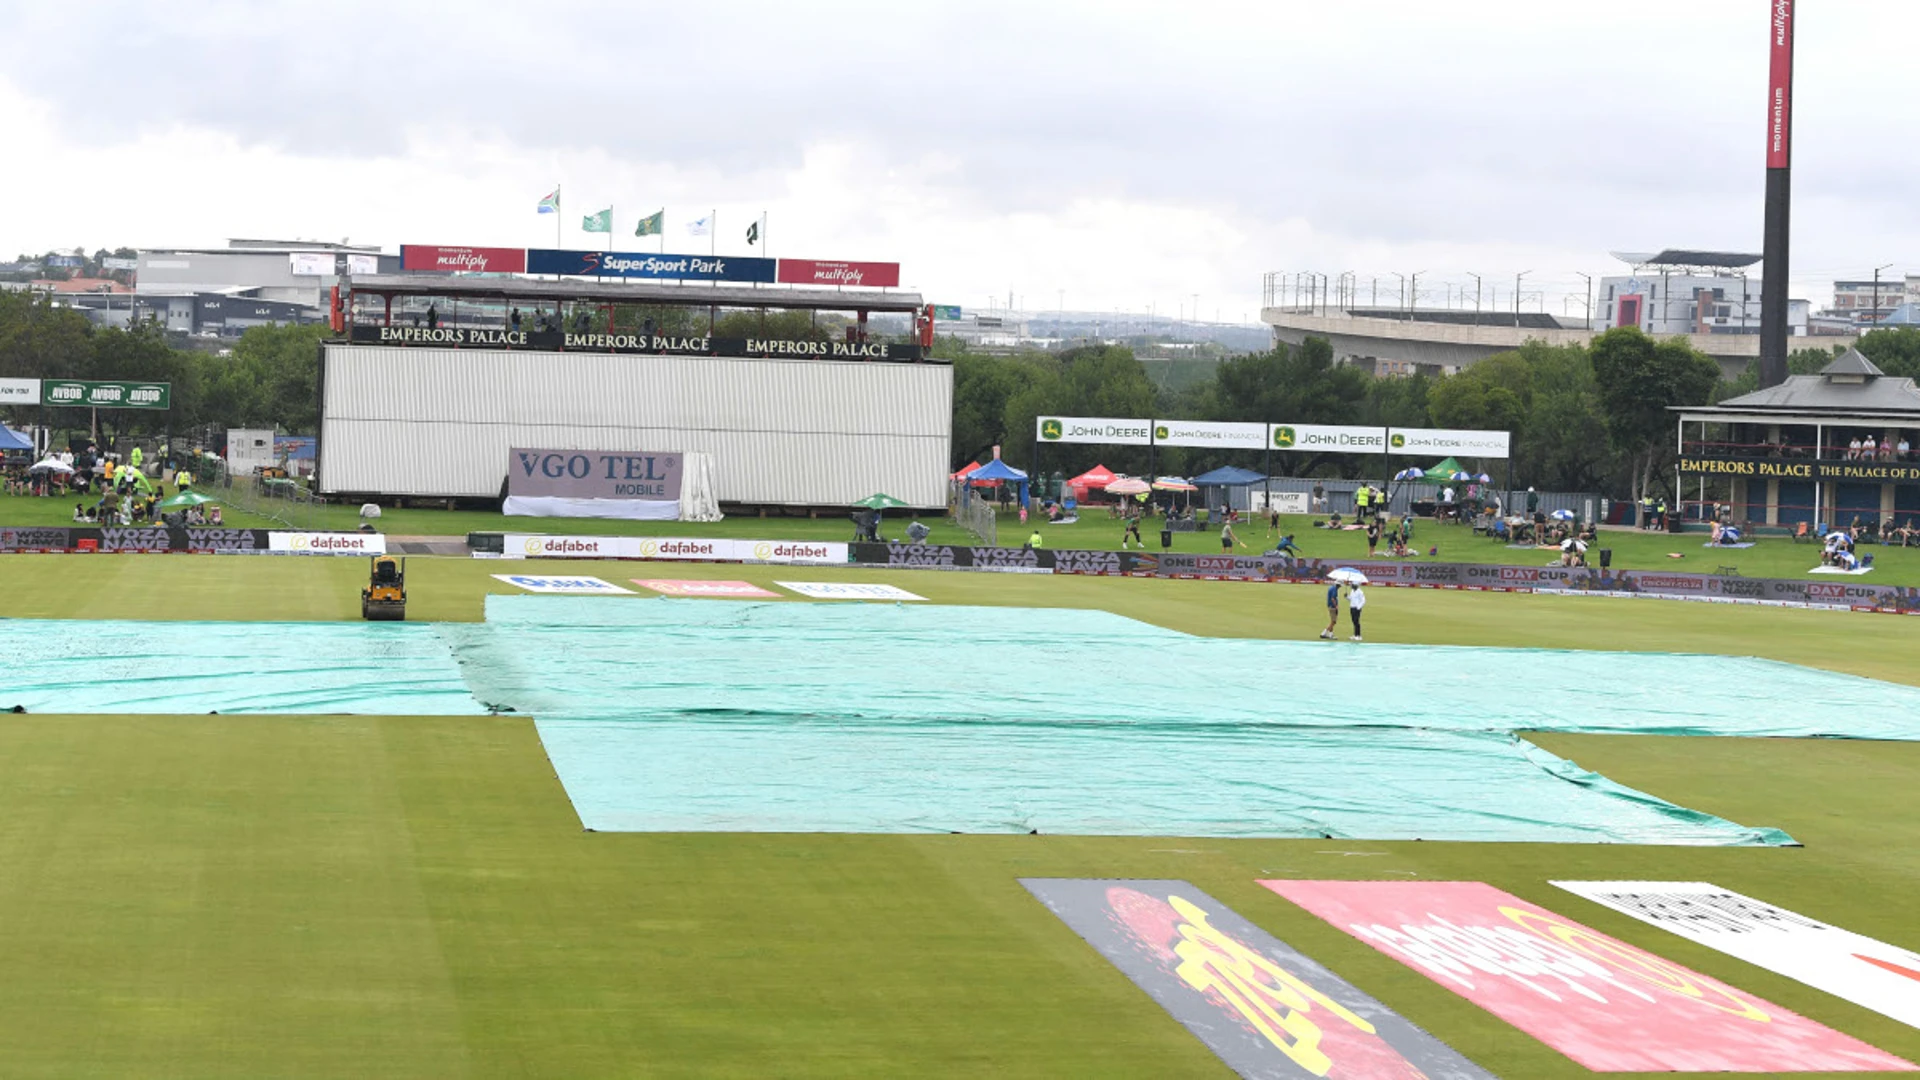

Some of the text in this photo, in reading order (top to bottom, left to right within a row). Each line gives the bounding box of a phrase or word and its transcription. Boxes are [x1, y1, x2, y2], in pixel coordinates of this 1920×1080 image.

[1774, 88, 1783, 152] momentum
[437, 253, 489, 270] multiply
[603, 255, 726, 274] SuperSport Park
[814, 268, 864, 284] multiply
[380, 328, 527, 344] EMPERORS PALACE
[564, 333, 710, 350] EMPERORS PALACE
[746, 339, 889, 357] EMPERORS PALACE
[52, 387, 83, 399] AVBOB
[91, 388, 121, 401] AVBOB
[130, 390, 160, 402] AVBOB
[1068, 425, 1148, 438] JOHN DEERE
[1301, 432, 1383, 446] JOHN DEERE
[518, 453, 666, 481] VGO TEL
[1680, 459, 1920, 479] EMPERORS PALACE THE PALACE OF D
[615, 484, 665, 495] MOBILE
[101, 528, 170, 539] WOZA
[186, 529, 255, 540] WOZA
[103, 539, 170, 550] NAWE
[188, 540, 255, 550] NAWE
[311, 537, 364, 550] dafabet
[545, 540, 599, 553] dafabet
[660, 542, 713, 555] dafabet
[888, 544, 954, 556] WOZA
[774, 545, 827, 559] dafabet
[972, 547, 1039, 559] WOZA
[1054, 551, 1120, 563] WOZA
[889, 555, 954, 566] NAWE
[973, 558, 1039, 568] NAWE
[1055, 561, 1121, 572] NAWE
[1164, 557, 1264, 569] ONE DAY CUP
[1468, 568, 1568, 580] ONE DAY CUP
[1775, 583, 1805, 593] ONE
[1810, 584, 1841, 596] DAY
[1845, 588, 1876, 598] CUP
